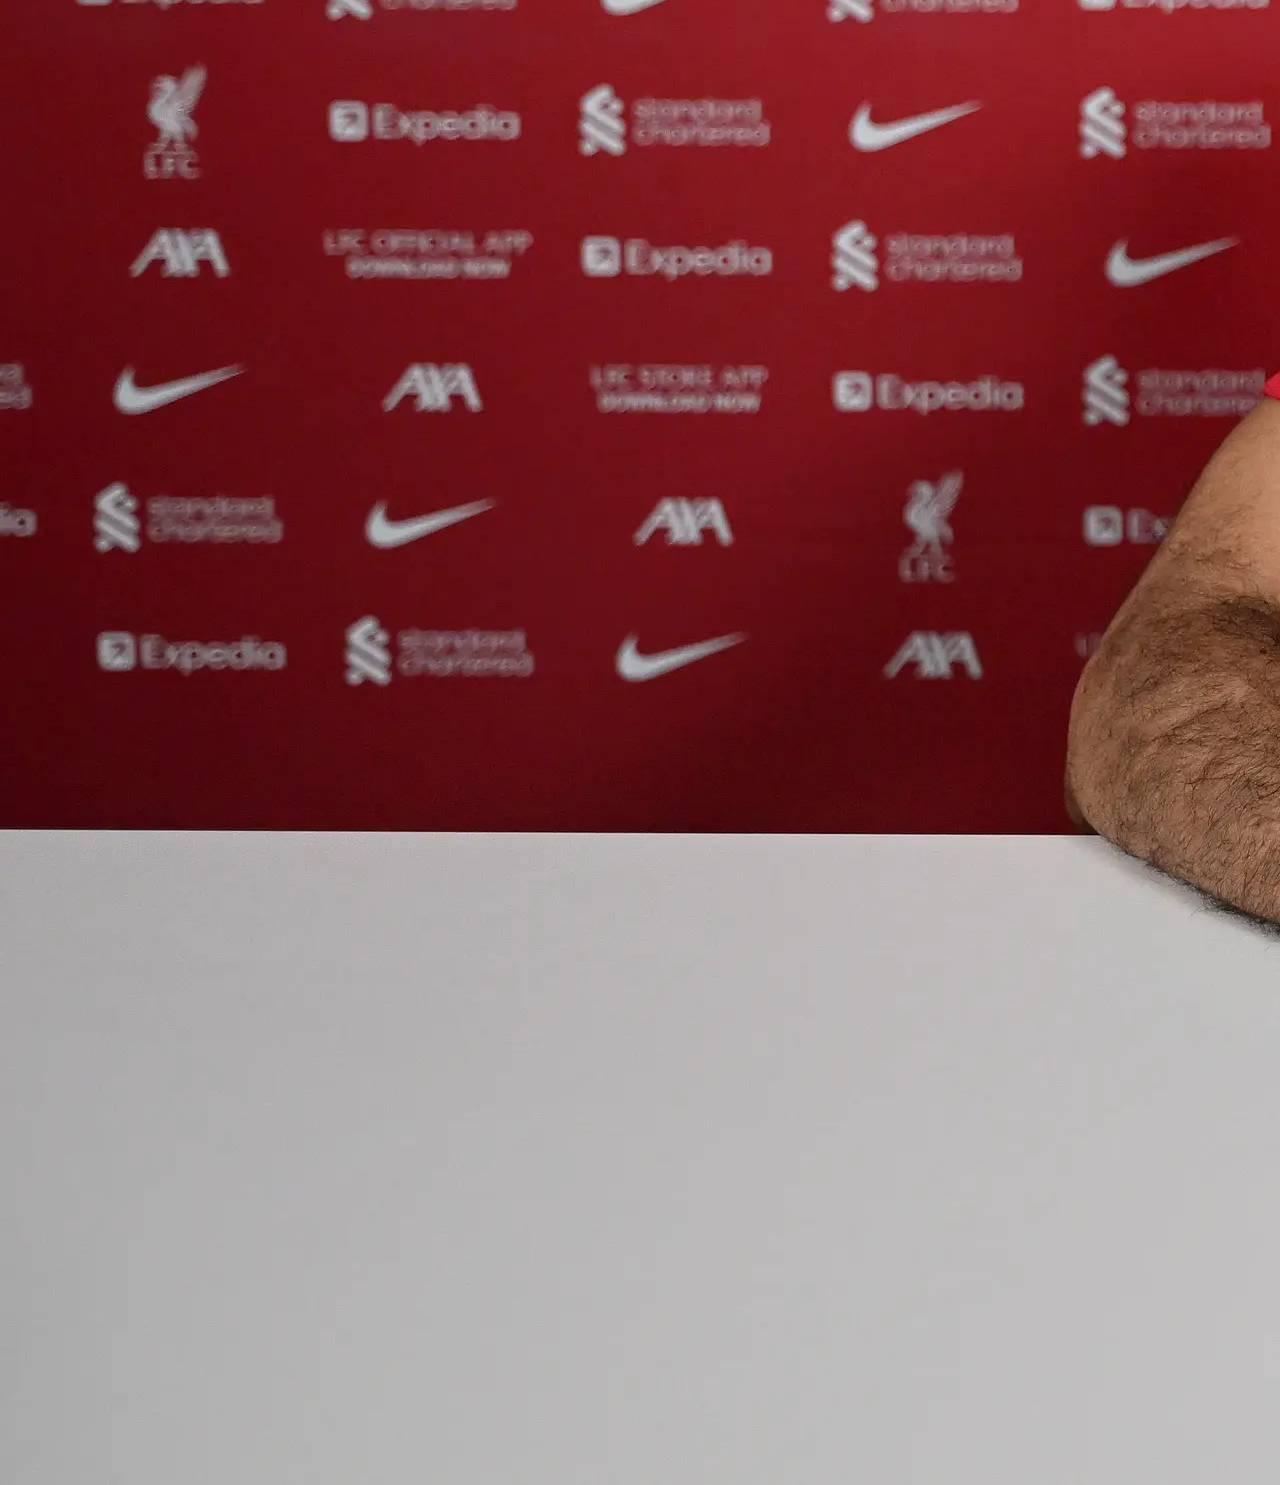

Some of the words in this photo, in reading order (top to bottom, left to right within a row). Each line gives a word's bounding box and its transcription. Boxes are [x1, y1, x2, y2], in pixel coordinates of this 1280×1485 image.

[373, 104, 521, 142] Expedia
[130, 228, 230, 277] AXA
[625, 240, 774, 278] Expedia
[383, 363, 482, 412] AXA
[877, 375, 1025, 412] Expedia
[634, 497, 733, 546] AXA
[141, 635, 287, 672] Expedia
[884, 631, 982, 679] AXA
